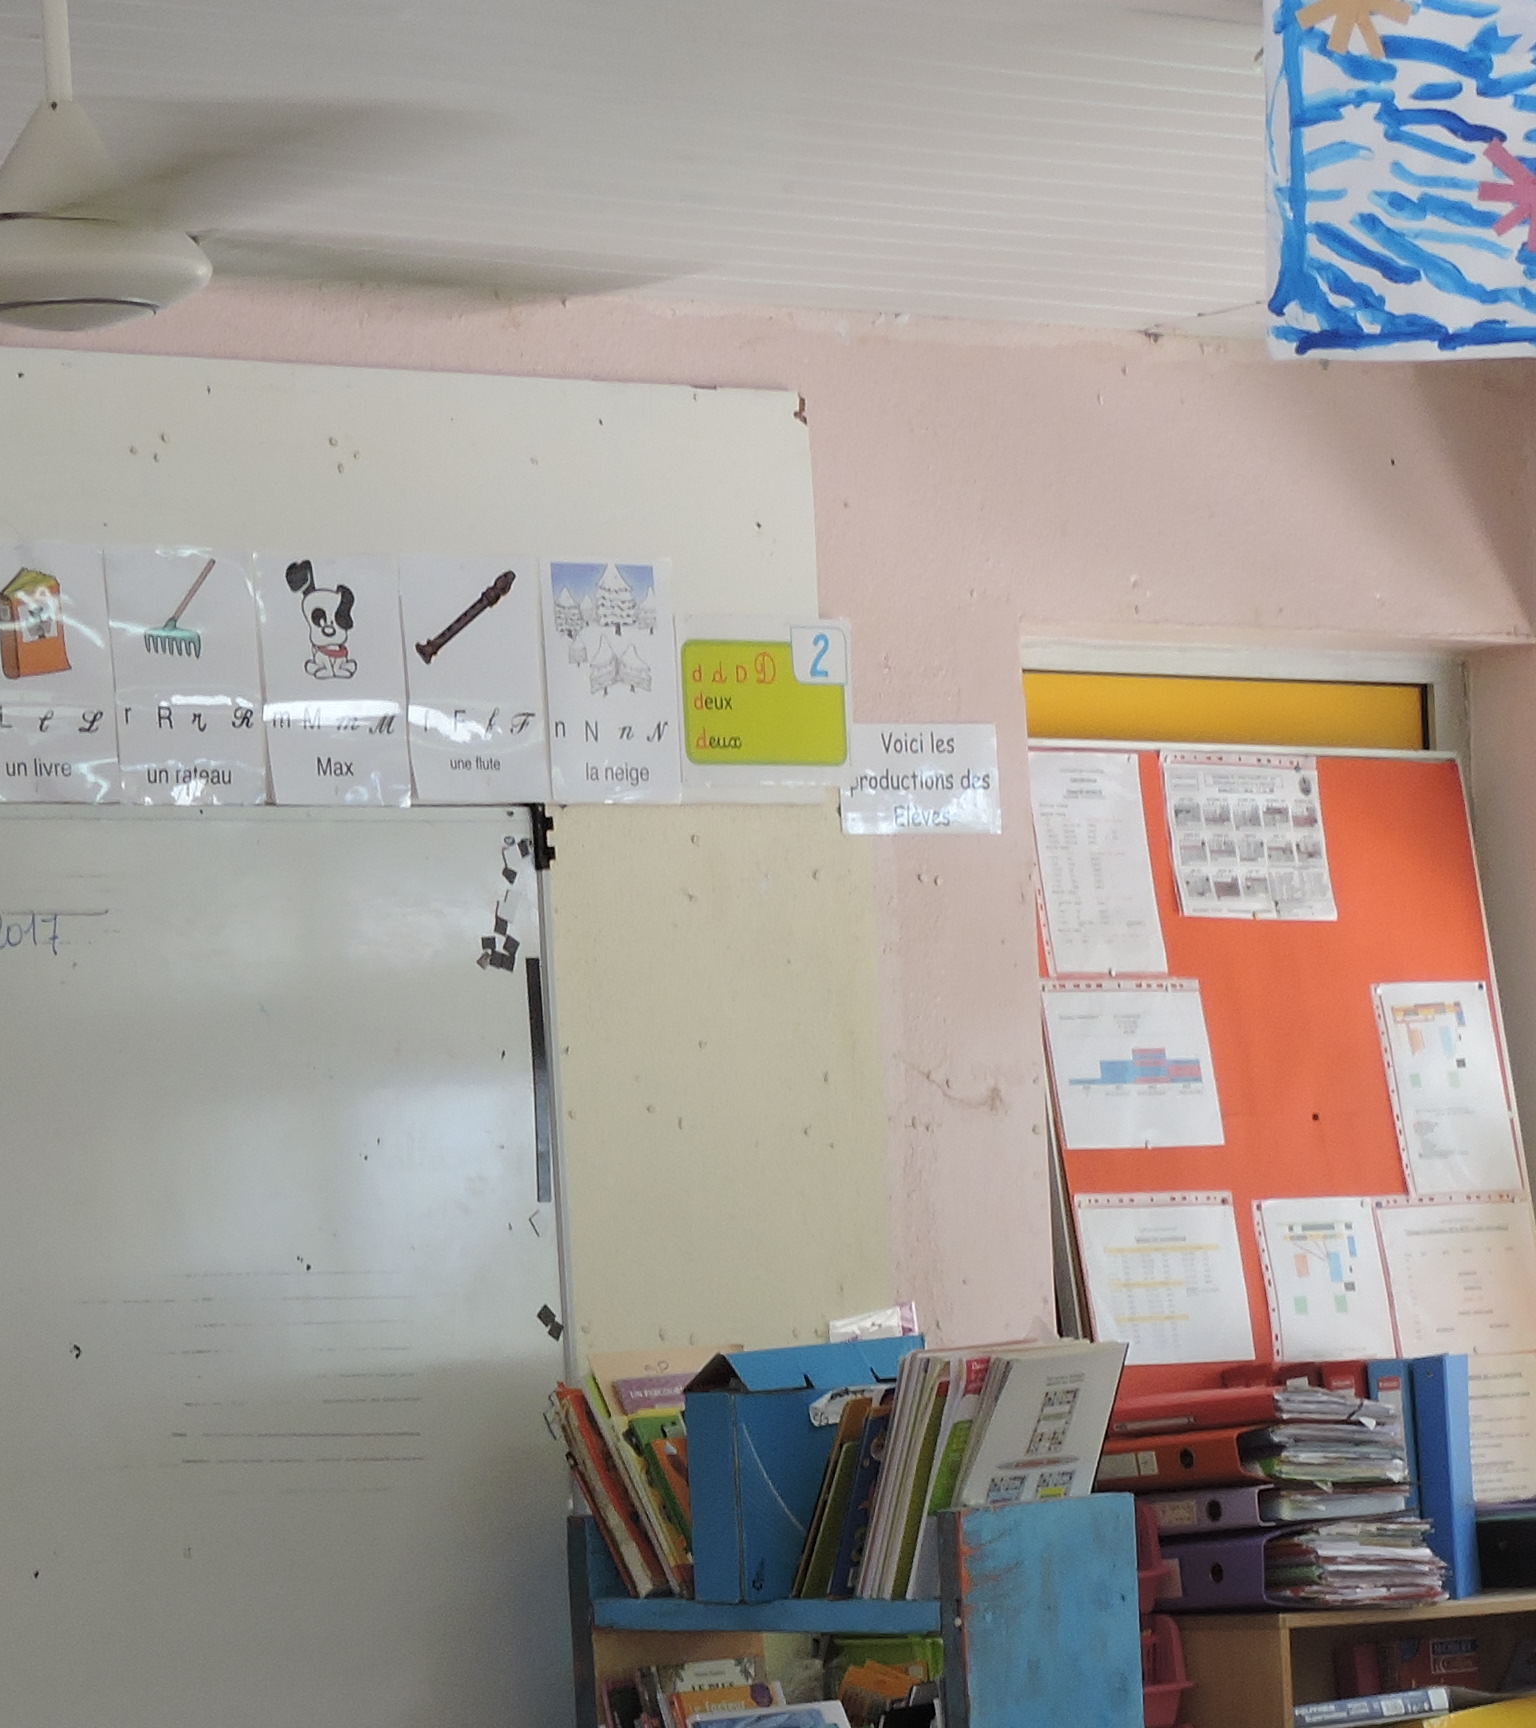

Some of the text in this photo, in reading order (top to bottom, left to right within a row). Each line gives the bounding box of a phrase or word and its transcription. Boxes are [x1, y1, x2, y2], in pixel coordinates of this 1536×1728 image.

[810, 633, 830, 679] 2
[692, 664, 702, 682] d
[735, 665, 748, 683] D
[694, 692, 733, 711] deux
[0, 706, 13, 729] L
[157, 705, 174, 730] R
[555, 721, 566, 738] n
[585, 721, 598, 742] N
[695, 732, 743, 751] deux
[881, 732, 955, 755] Voici les
[6, 758, 72, 778] un livre
[316, 757, 354, 776] Max
[450, 758, 471, 770] une
[147, 766, 171, 784] un
[585, 763, 650, 786] la neige
[850, 768, 991, 797] productions des
